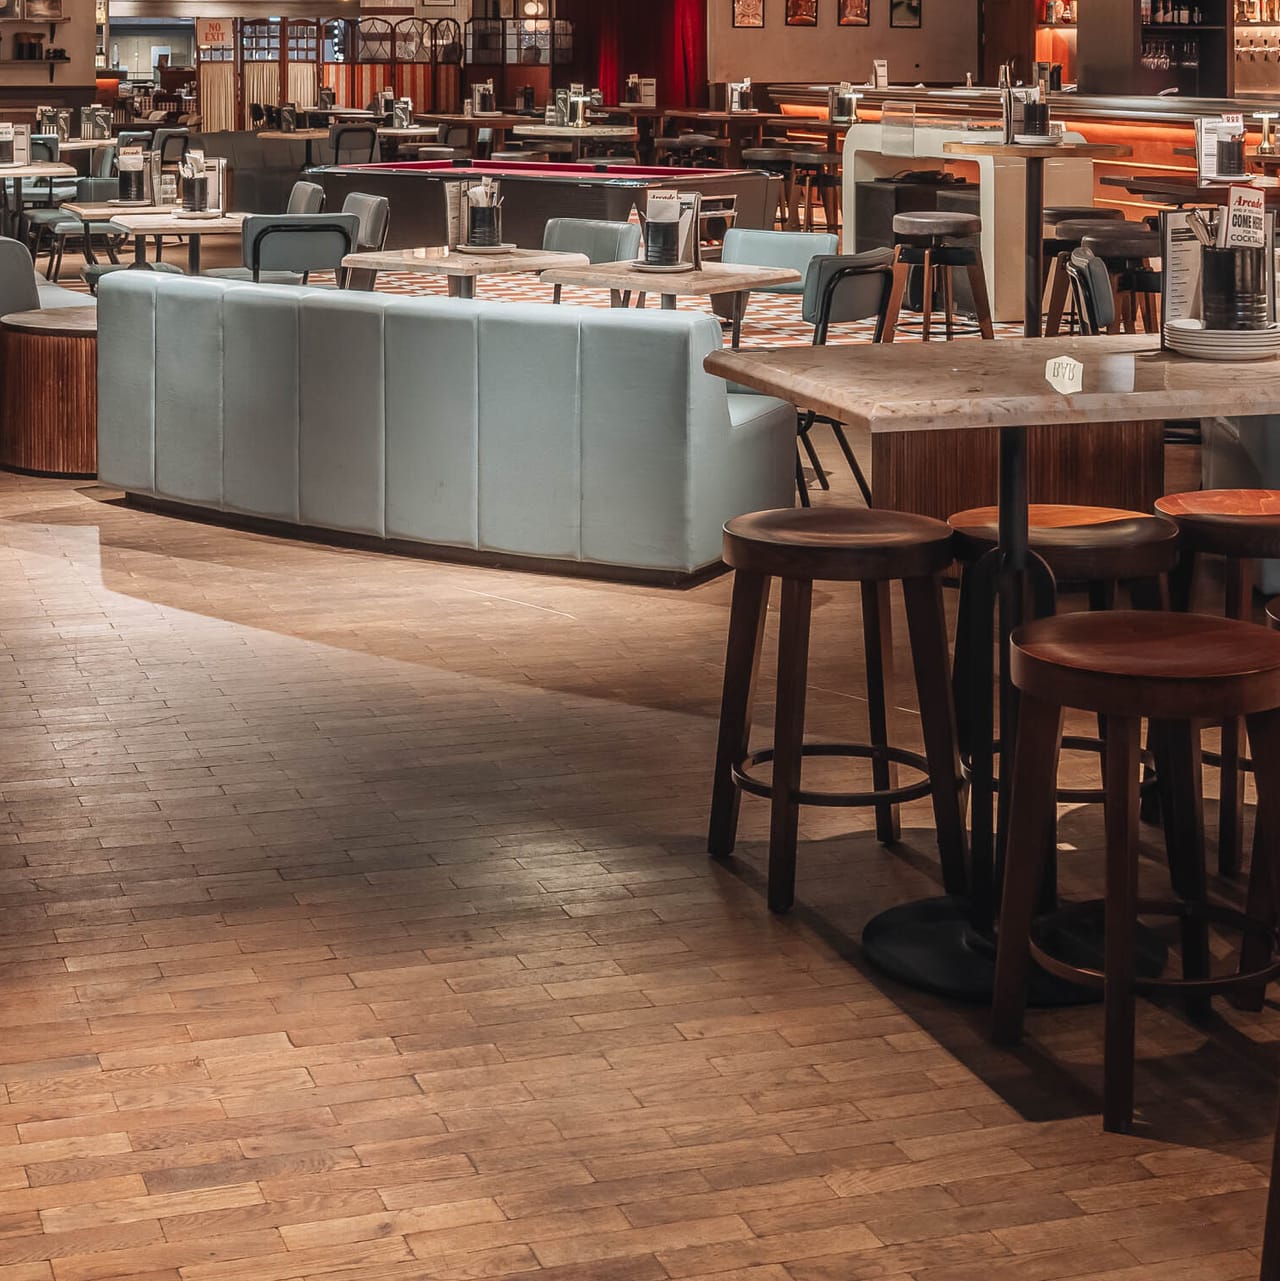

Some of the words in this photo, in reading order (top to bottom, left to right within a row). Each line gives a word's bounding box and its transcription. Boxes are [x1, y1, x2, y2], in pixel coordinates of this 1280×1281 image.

[208, 22, 222, 32] NO
[205, 32, 225, 42] EXIT
[1233, 195, 1263, 209] Arcade
[1232, 214, 1251, 228] COME
